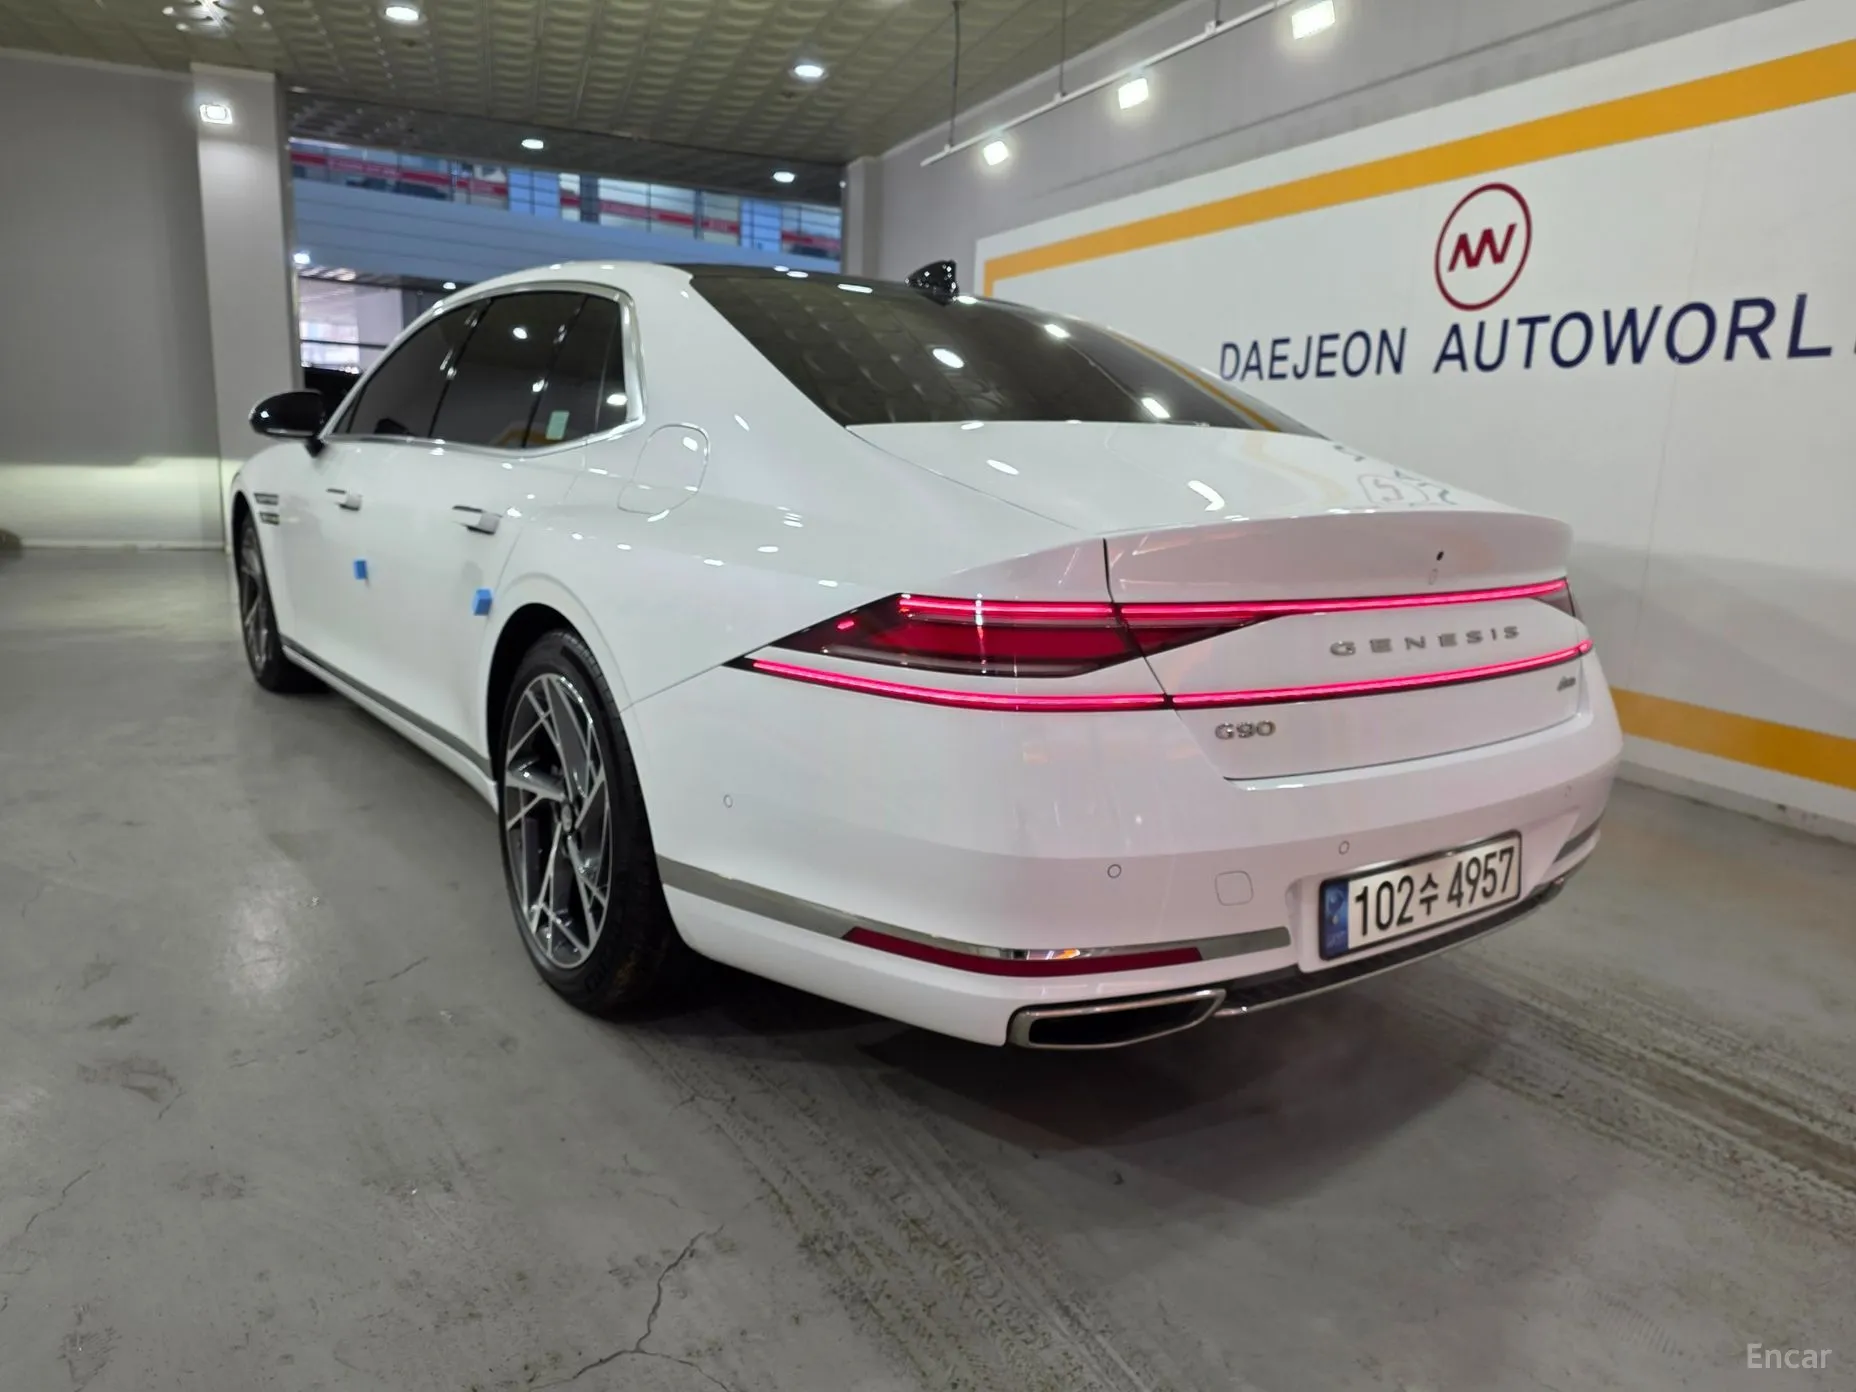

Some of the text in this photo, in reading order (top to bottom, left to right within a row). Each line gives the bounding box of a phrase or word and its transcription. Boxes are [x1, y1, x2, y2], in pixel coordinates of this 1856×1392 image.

[1220, 293, 1856, 382] DAEJEON AUTOWORL
[1330, 625, 1520, 657] GENESIS
[1214, 720, 1277, 740] G90
